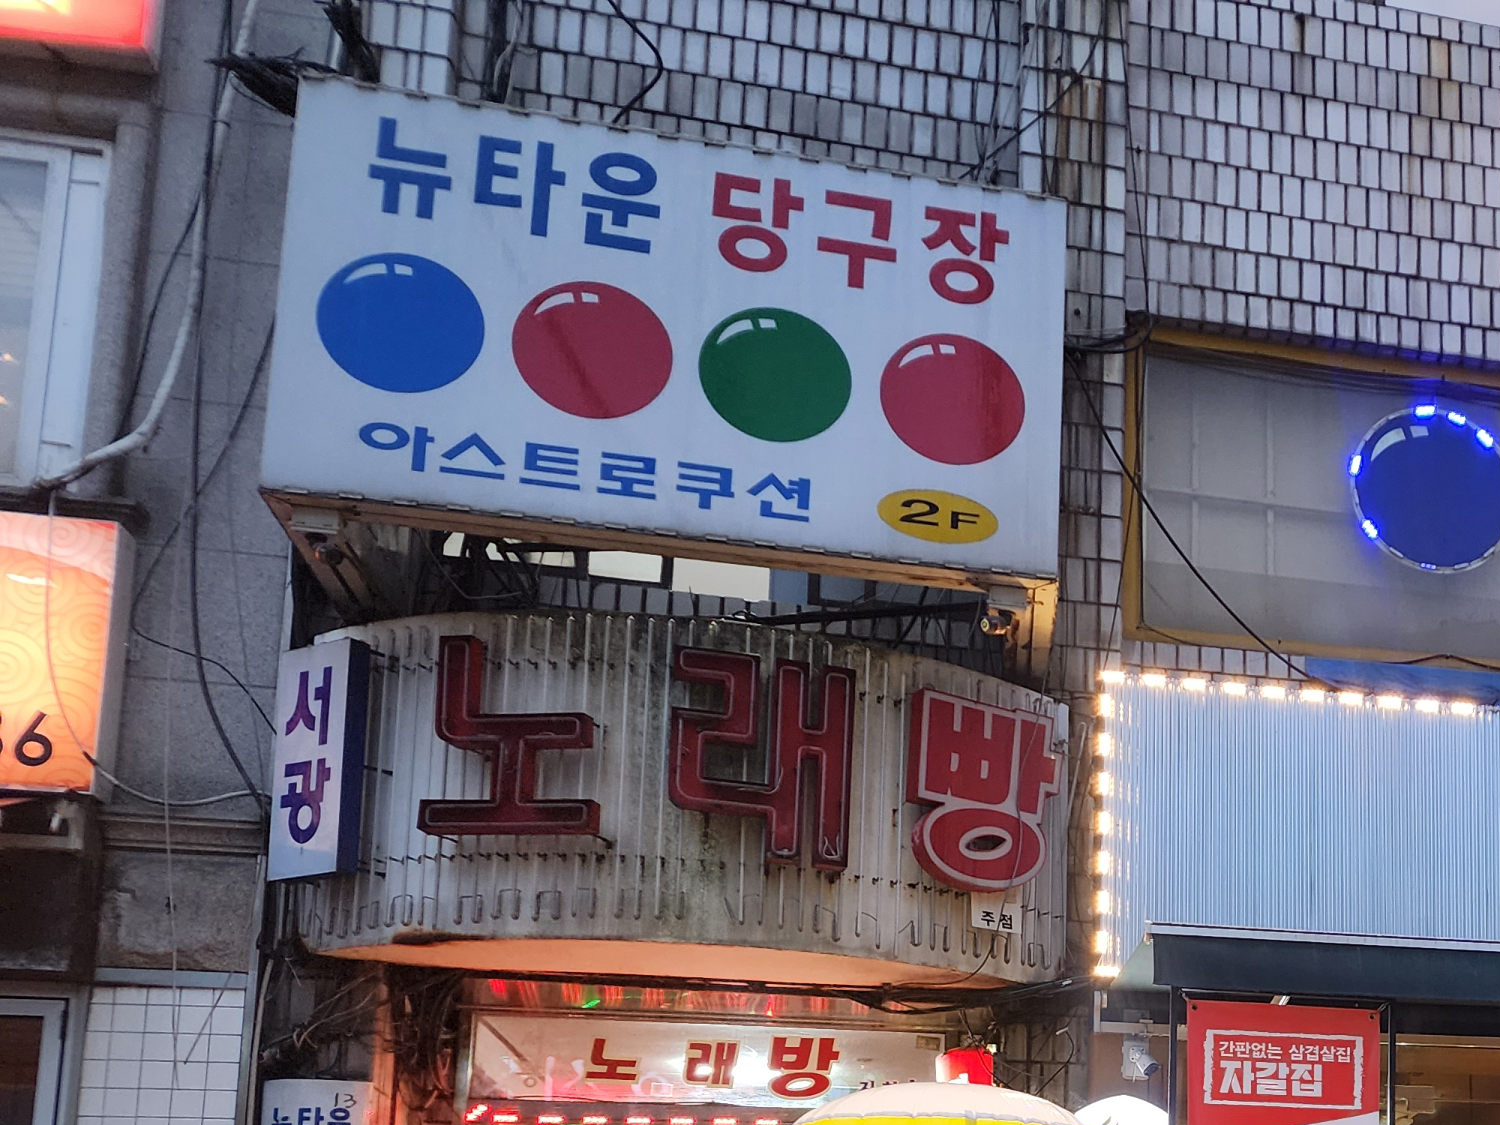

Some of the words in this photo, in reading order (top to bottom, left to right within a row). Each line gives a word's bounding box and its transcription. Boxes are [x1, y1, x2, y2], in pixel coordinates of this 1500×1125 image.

[368, 116, 661, 254] 뉴타운
[712, 172, 1010, 304] 당구장
[359, 422, 811, 523] 아스트로쿠션
[899, 500, 981, 530] 2F
[281, 666, 333, 844] 서광
[981, 909, 1015, 932] 주점
[585, 1035, 841, 1099] 노래방
[1219, 1040, 1282, 1060] 간판없는
[1289, 1044, 1351, 1063] 삼겹살집
[1219, 1060, 1323, 1098] 자갈집
